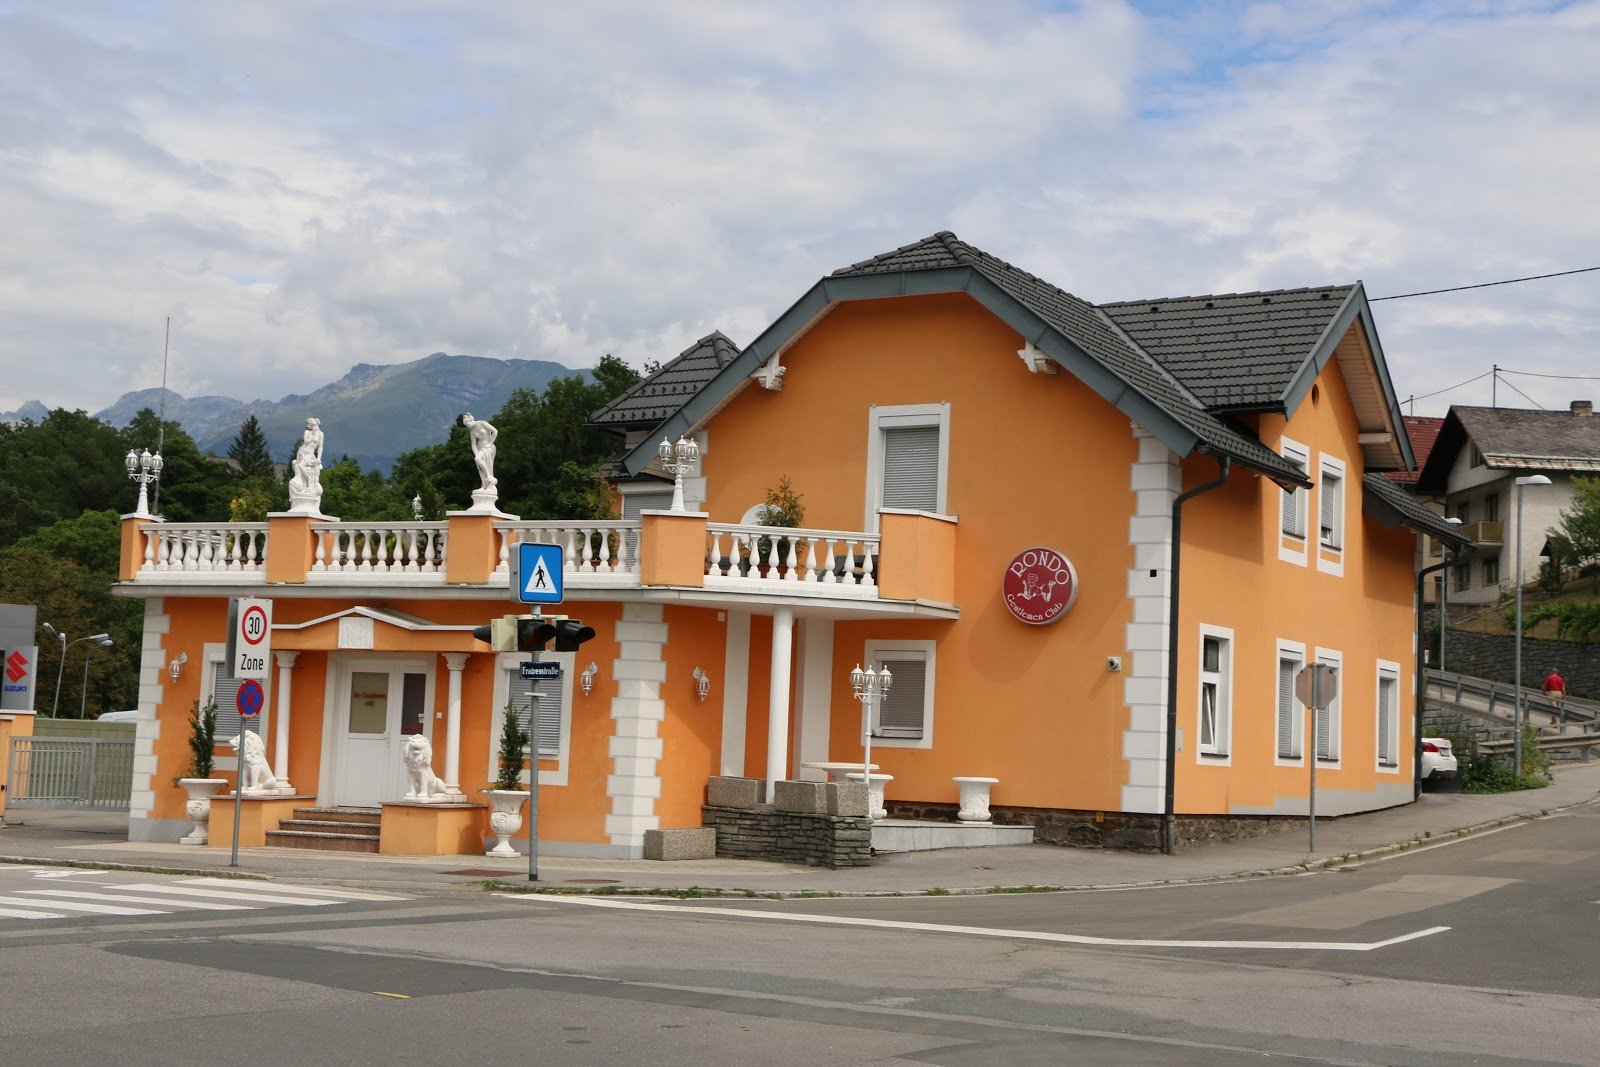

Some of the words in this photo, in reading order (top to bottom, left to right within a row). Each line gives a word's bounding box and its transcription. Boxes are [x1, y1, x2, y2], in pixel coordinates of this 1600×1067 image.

[1010, 551, 1069, 585] RONDO
[1007, 594, 1043, 620] Gentlemen
[1045, 602, 1063, 618] Club
[248, 617, 260, 634] 30
[240, 654, 264, 671] Zone
